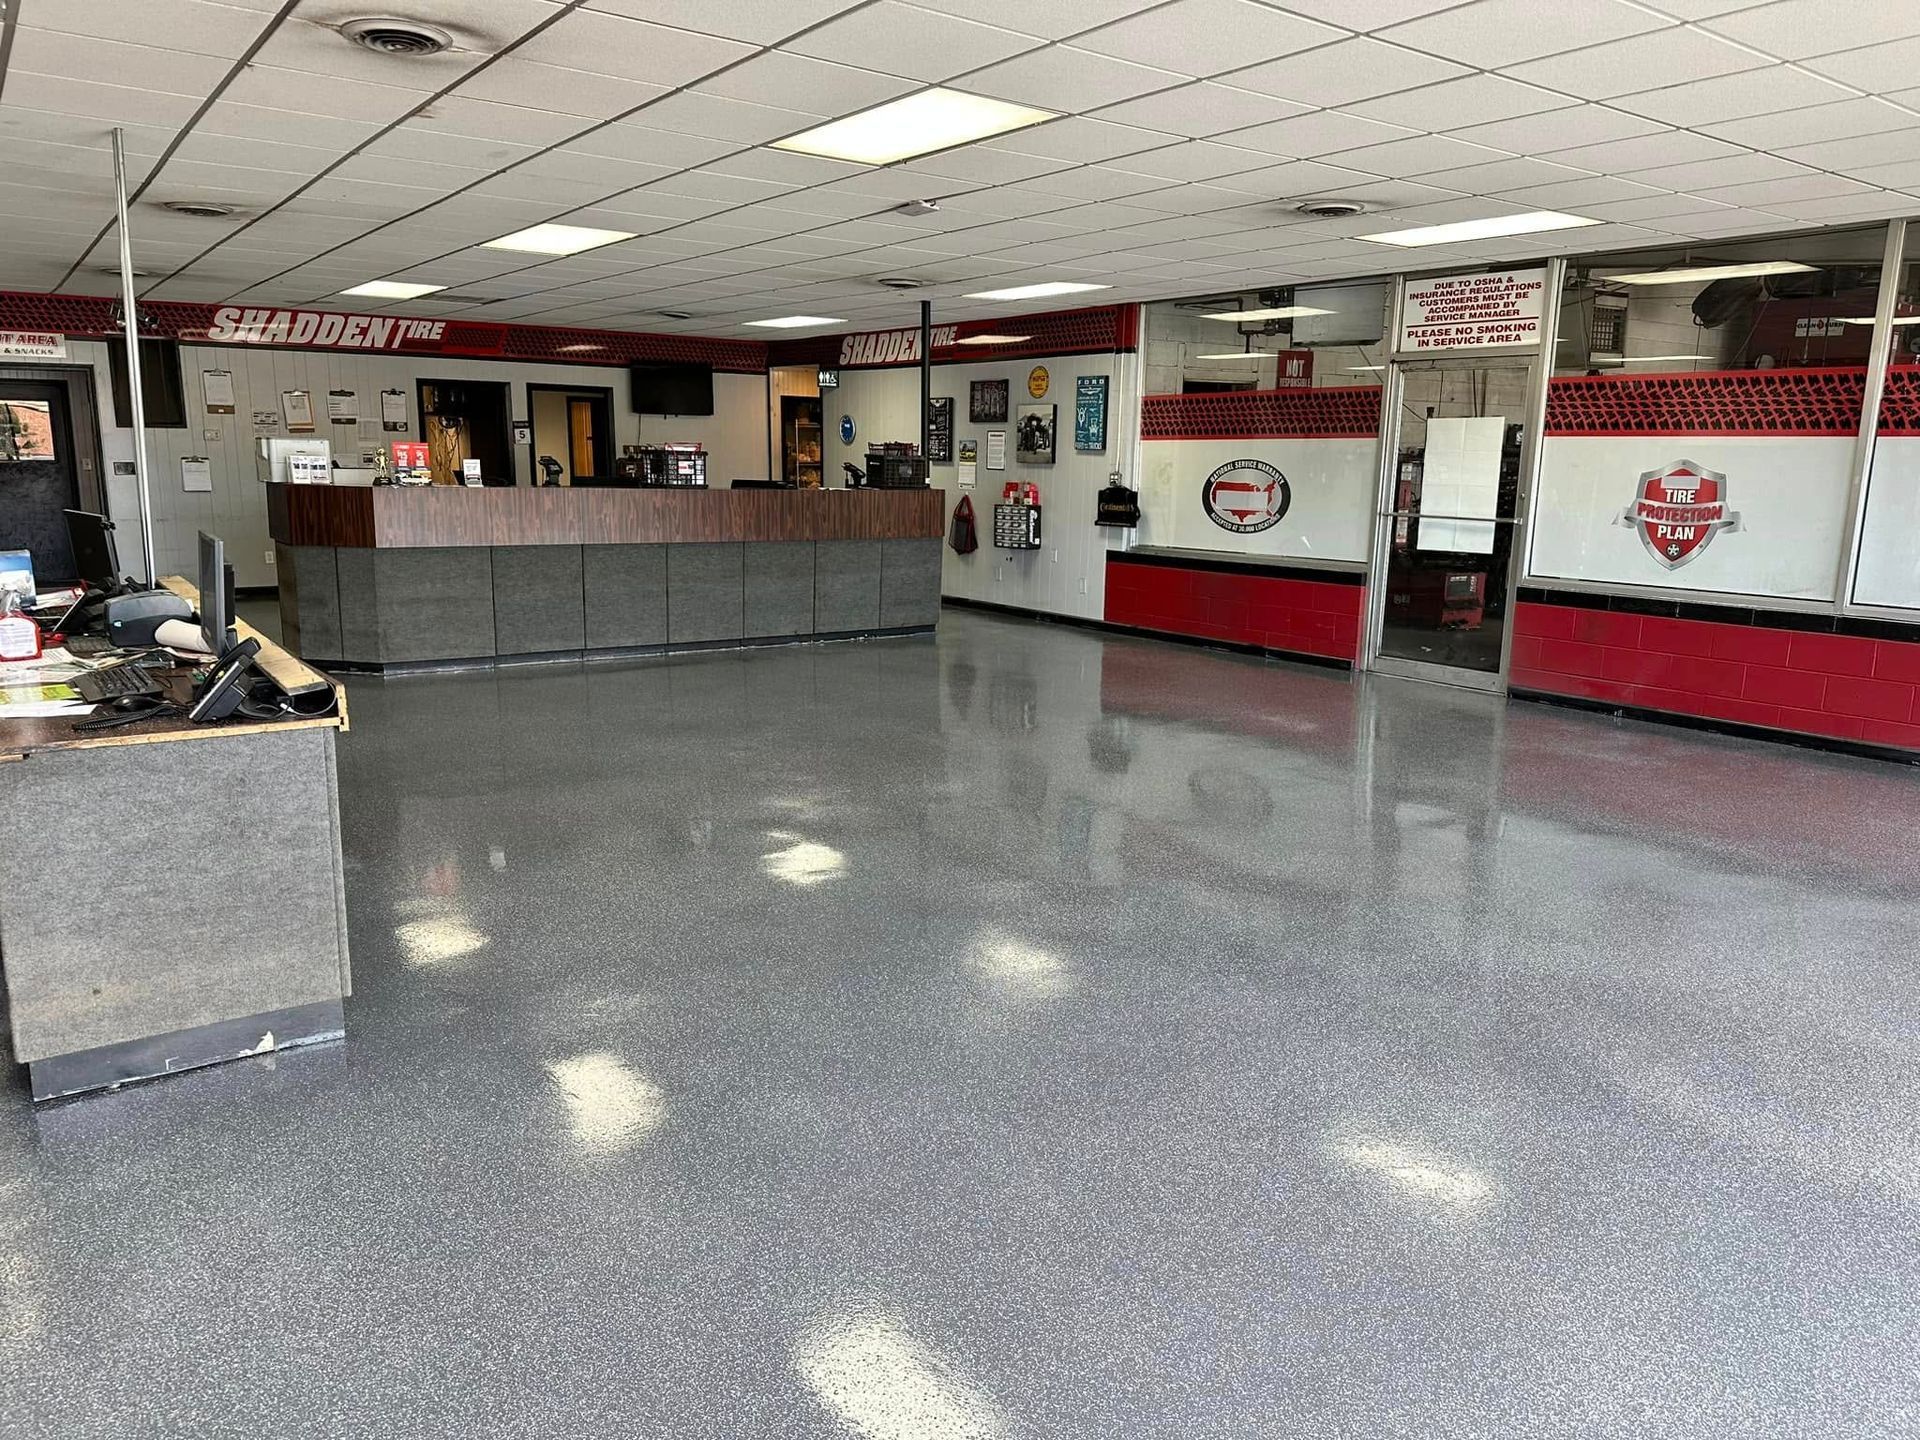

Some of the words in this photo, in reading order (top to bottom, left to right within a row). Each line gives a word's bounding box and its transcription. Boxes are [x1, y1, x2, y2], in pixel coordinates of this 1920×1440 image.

[1410, 289, 1467, 300] INSURANCE
[1469, 282, 1542, 294] REGULATIONS
[1434, 282, 1454, 290] DUE
[1458, 280, 1471, 288] TO
[1474, 277, 1503, 286] OSHA
[1419, 296, 1479, 307] CUSTOMERS
[1482, 293, 1512, 302] MUST
[1514, 291, 1529, 299] BE
[1424, 313, 1466, 322] SERVICE
[1468, 309, 1520, 319] MANAGER
[1428, 302, 1500, 314] ACCOMPANIED
[1503, 301, 1518, 309] BY
[208, 308, 395, 348] SHADDEN
[392, 319, 447, 348] TIRE
[1407, 328, 1452, 338] PLEASE
[1456, 327, 1473, 336] NO
[1477, 322, 1536, 334] SMOKING
[16, 334, 57, 346] AREA
[1418, 339, 1430, 347] IN
[1433, 336, 1484, 346] SERVICE
[1487, 334, 1522, 343] AREA
[1286, 359, 1304, 377] NOT
[1210, 463, 1234, 483] NATIONAL
[1235, 461, 1257, 469] SERVICE
[1258, 463, 1285, 484] WARRANTY
[1665, 489, 1695, 503] TIRE
[1638, 502, 1723, 522] PROTECTION
[1211, 513, 1232, 529] ACCEPTED
[1657, 525, 1695, 540] PLAN
